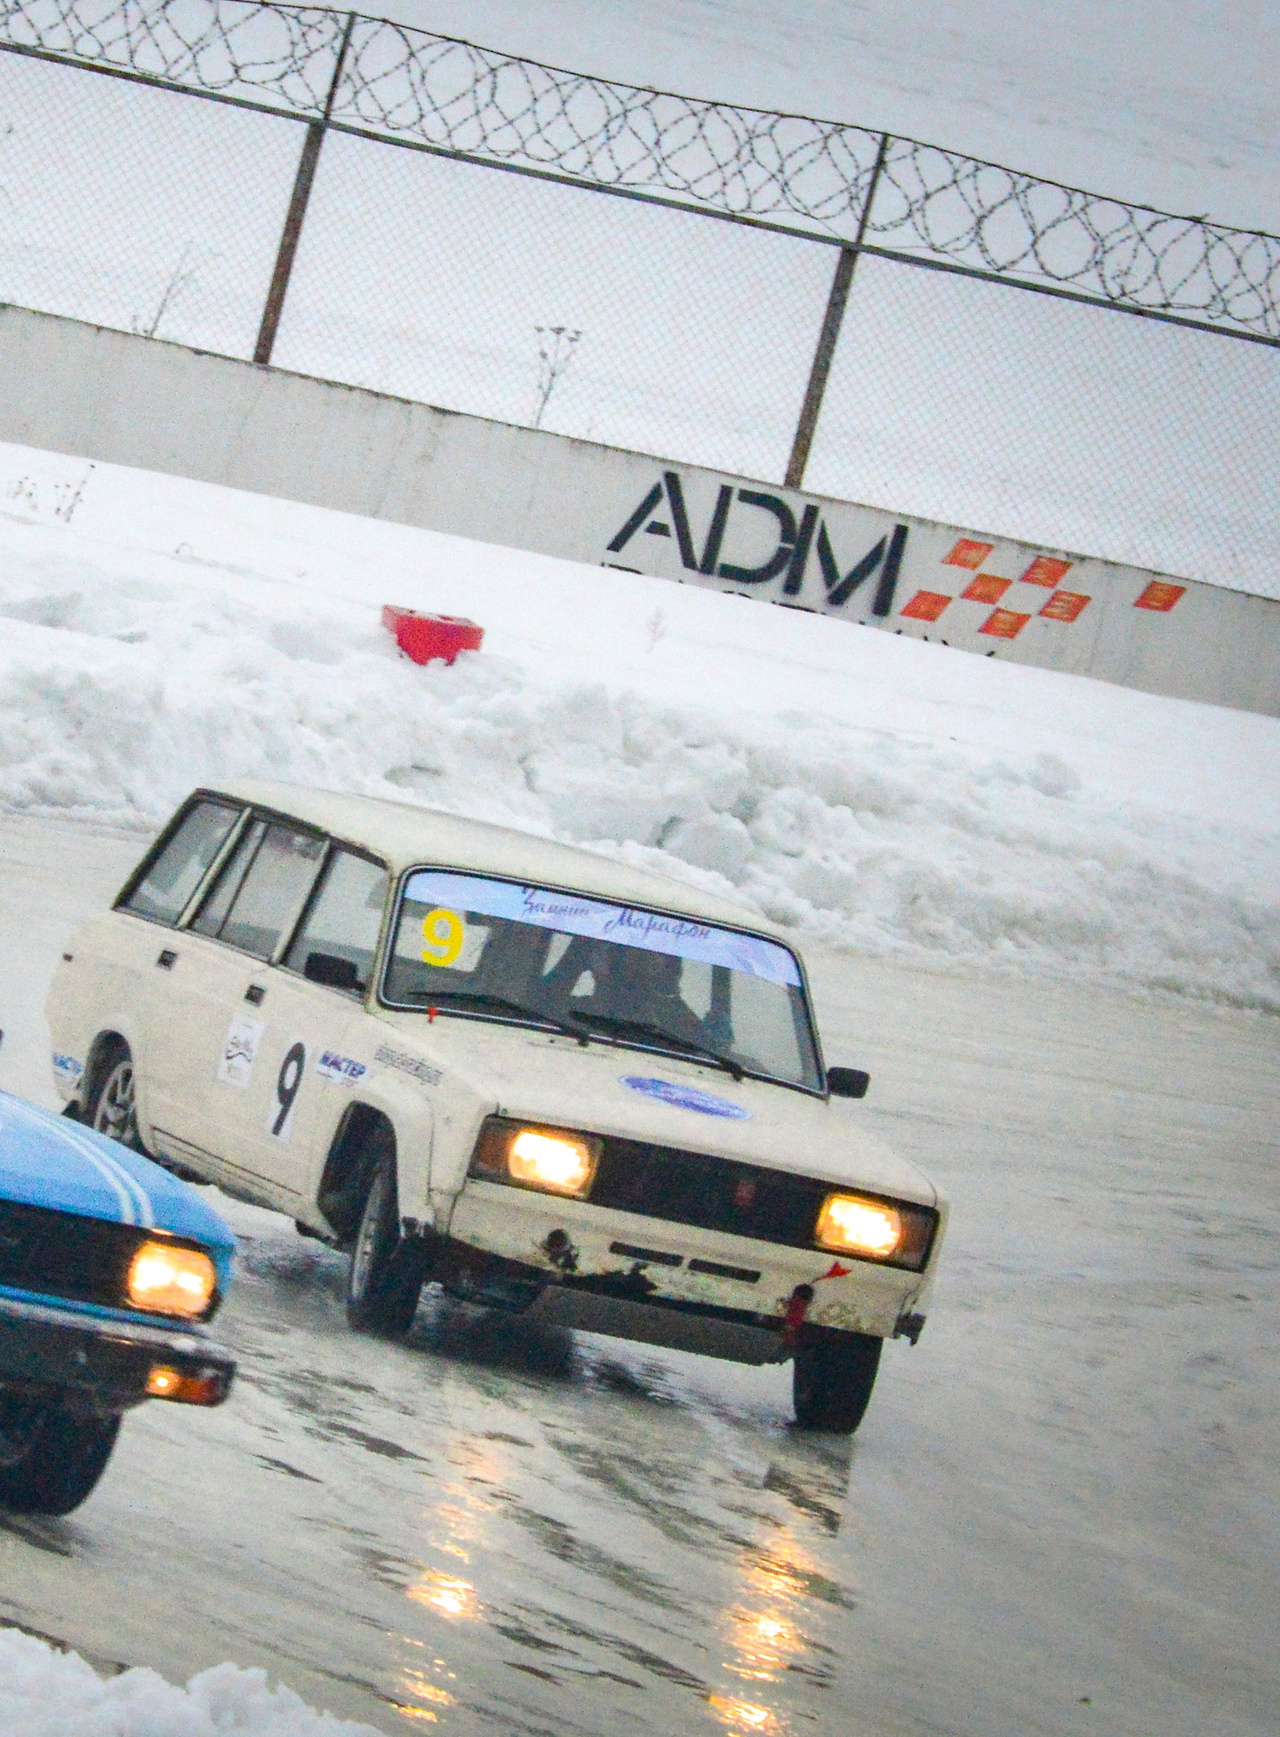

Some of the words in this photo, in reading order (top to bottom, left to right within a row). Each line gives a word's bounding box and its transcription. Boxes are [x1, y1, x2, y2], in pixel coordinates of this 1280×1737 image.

[606, 471, 909, 617] ADM
[422, 909, 463, 967] 9
[271, 1041, 305, 1136] 9
[319, 1049, 367, 1079] МАСТЕР
